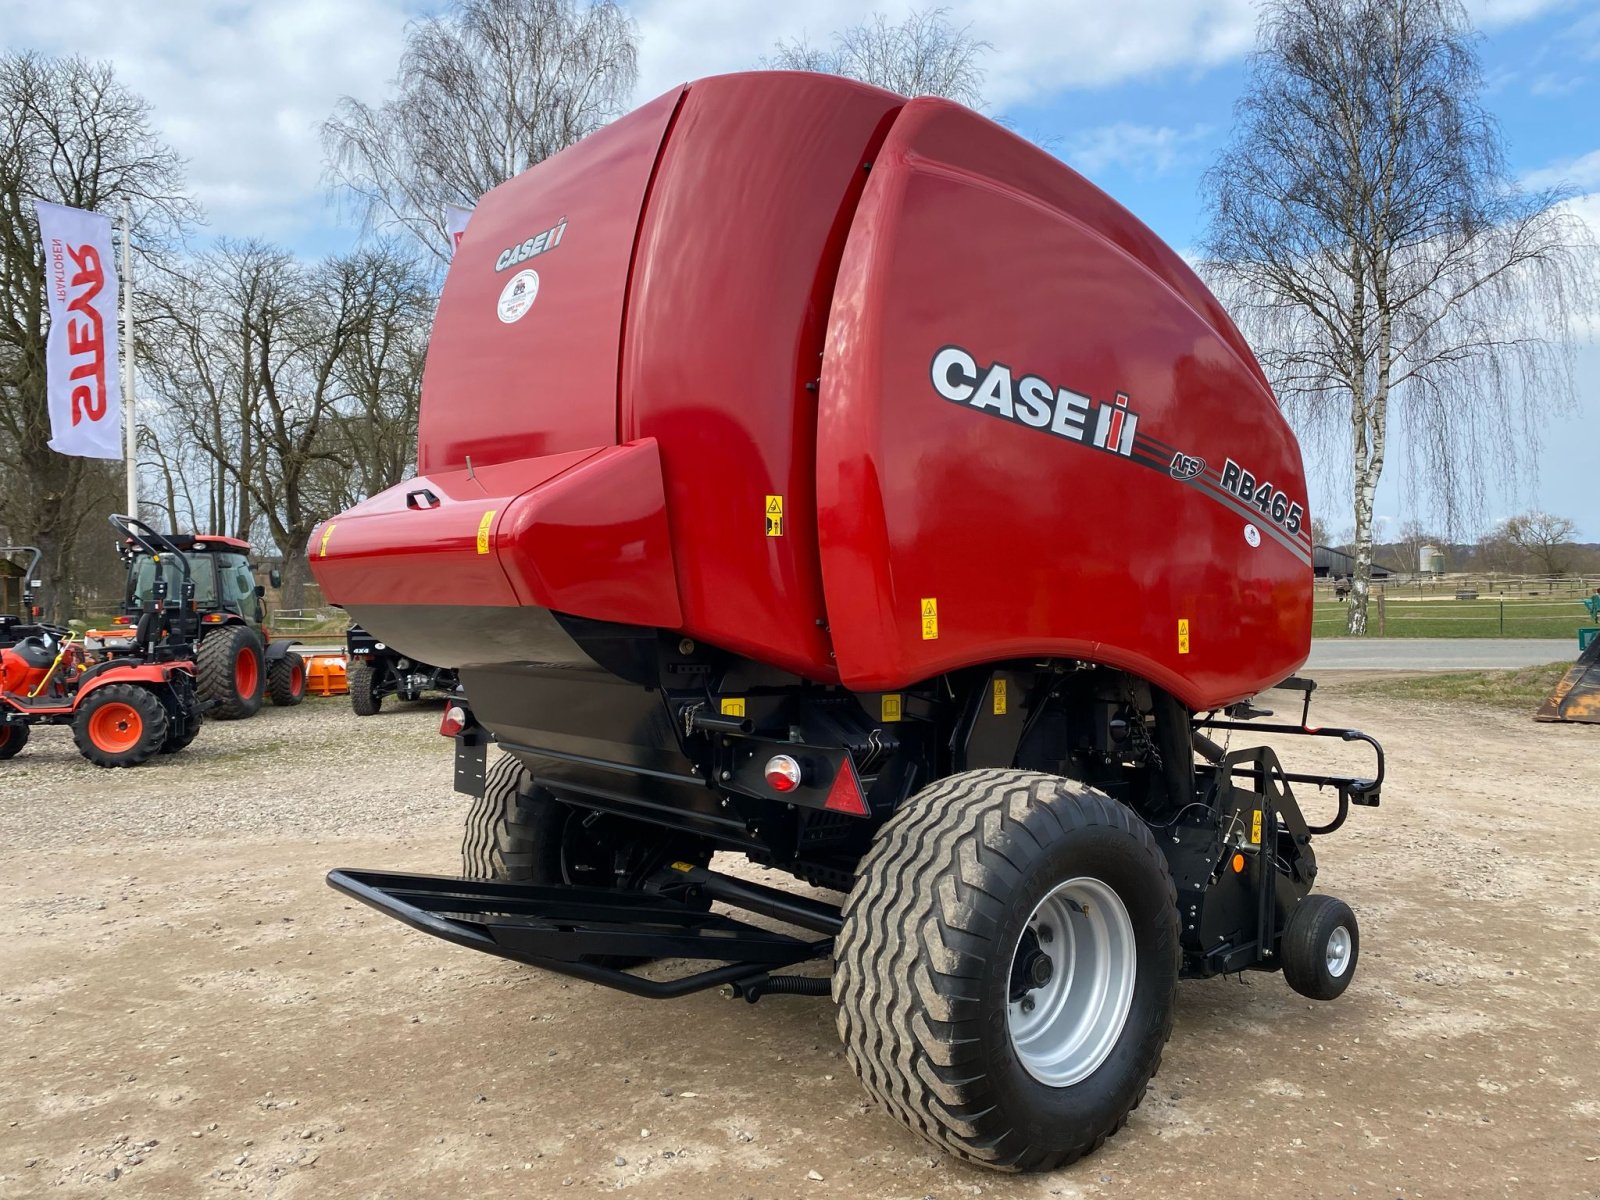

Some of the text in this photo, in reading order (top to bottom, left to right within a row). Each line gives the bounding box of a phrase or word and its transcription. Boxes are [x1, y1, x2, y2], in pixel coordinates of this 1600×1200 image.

[495, 231, 547, 272] CASE
[931, 347, 1091, 440] CASE
[1169, 452, 1199, 476] AFS
[1220, 457, 1303, 536] RB465
